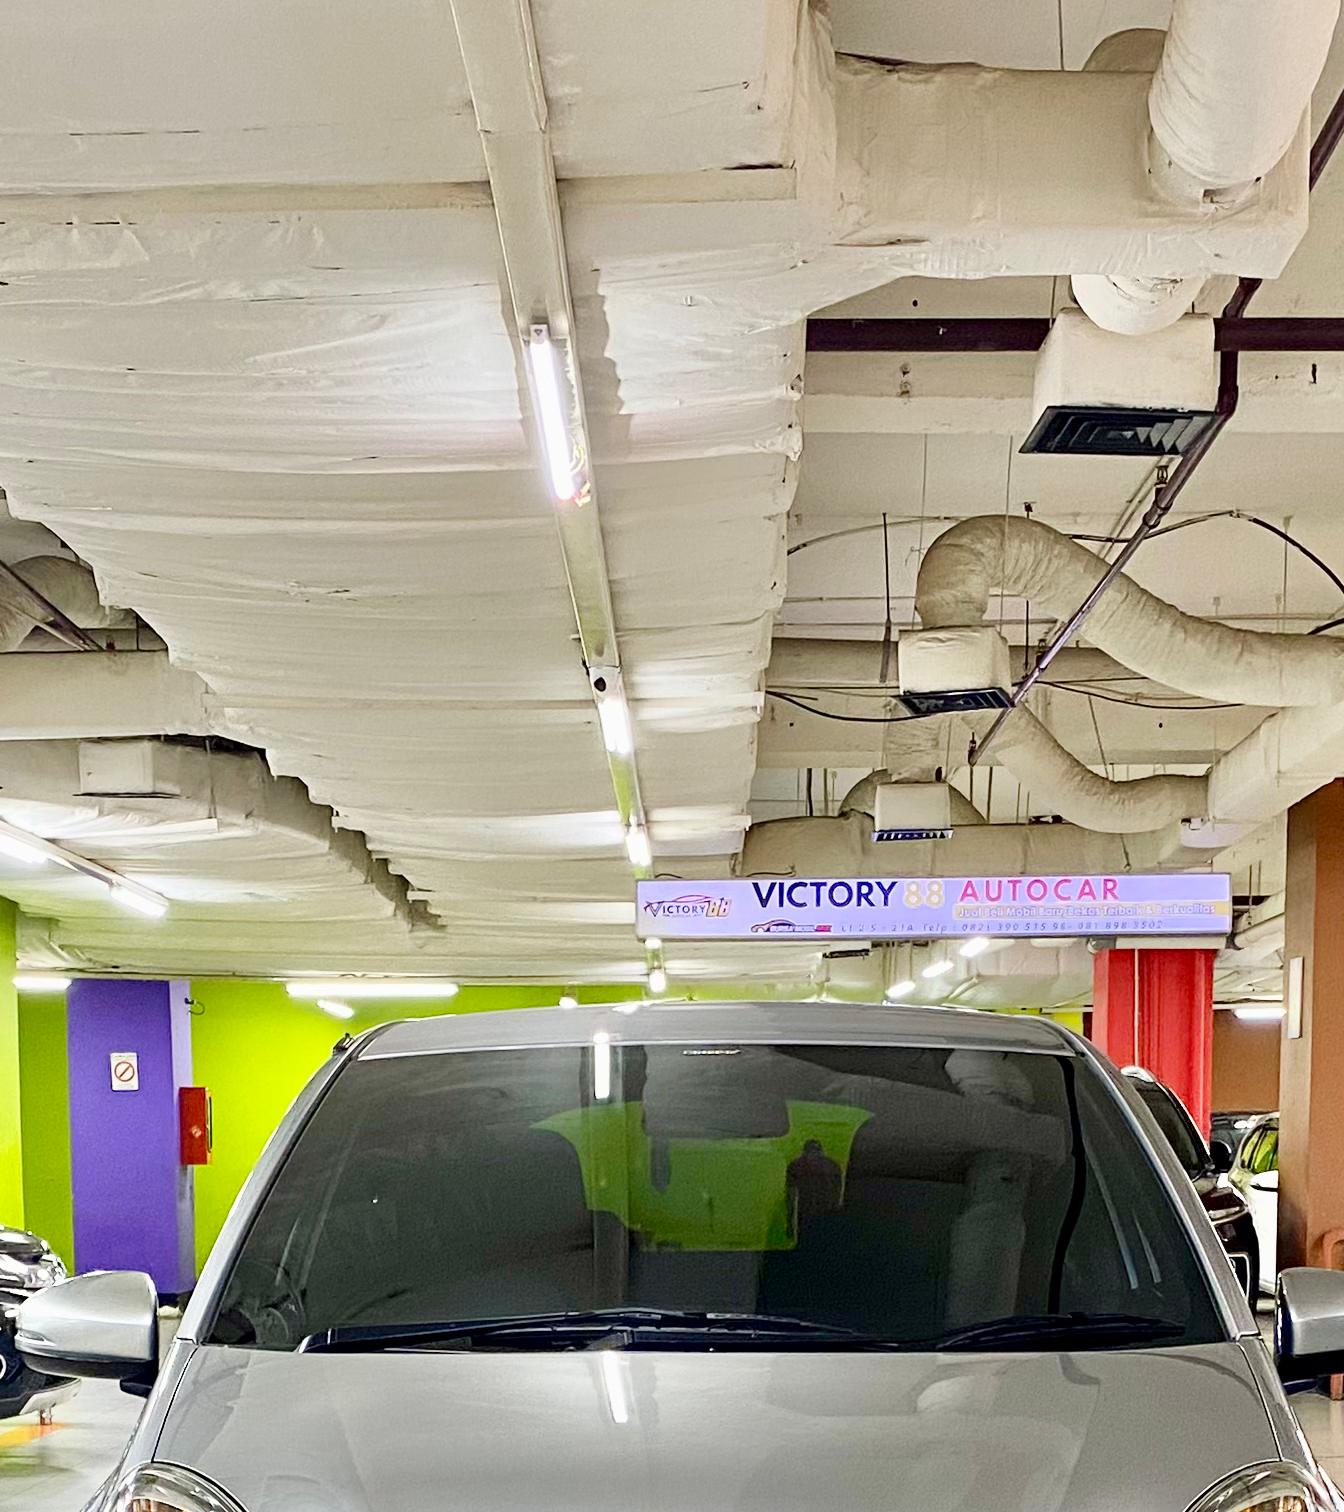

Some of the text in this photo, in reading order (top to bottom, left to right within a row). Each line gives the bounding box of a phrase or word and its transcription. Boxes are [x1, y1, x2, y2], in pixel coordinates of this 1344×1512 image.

[751, 879, 1120, 908] VICTORY 88 AUTOCAR
[644, 899, 706, 917] VICTORY
[1007, 906, 1037, 918] Mobil
